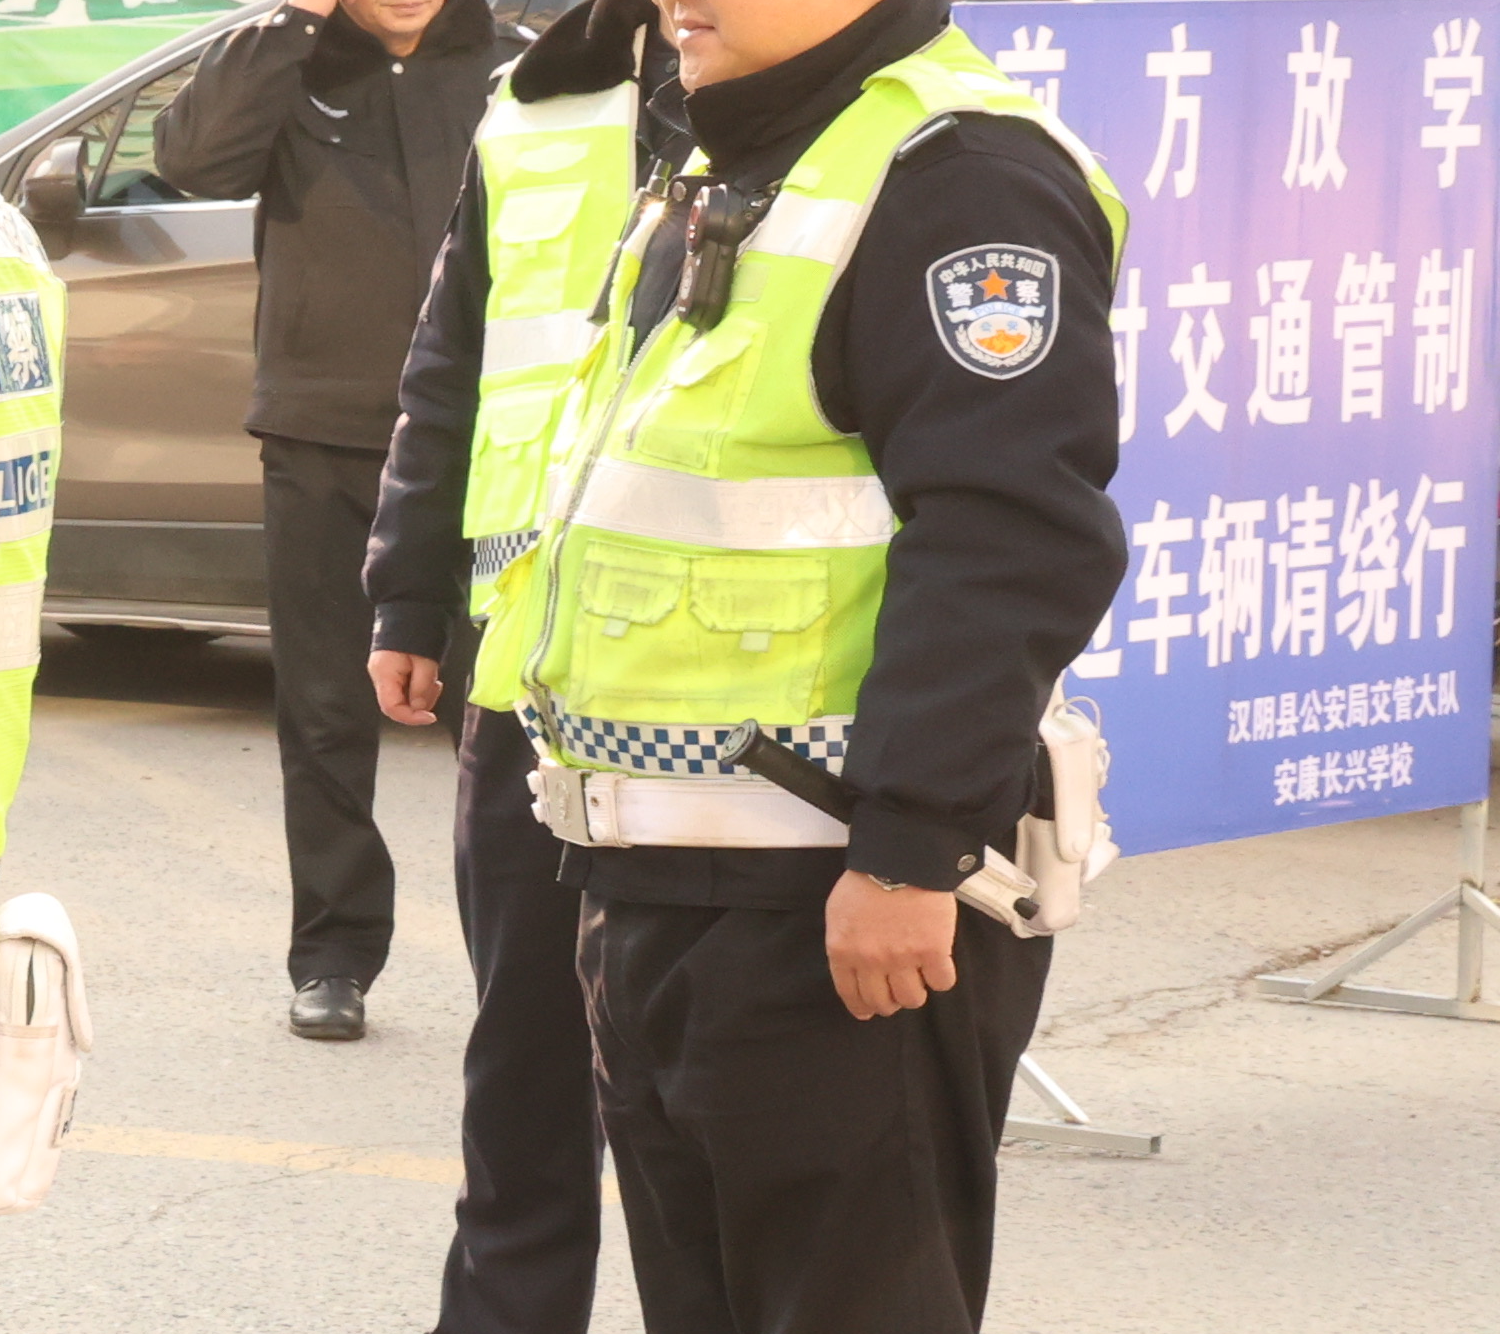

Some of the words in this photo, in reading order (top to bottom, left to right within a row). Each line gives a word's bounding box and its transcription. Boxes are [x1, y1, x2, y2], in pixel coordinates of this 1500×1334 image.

[938, 253, 1047, 284] 中华人民共和国
[946, 279, 1040, 308] 警察
[1071, 473, 1467, 680] 车辆请绕行
[1228, 670, 1460, 744] 汉阴县公安局交管大队
[1274, 742, 1415, 807] 安康长兴学校
